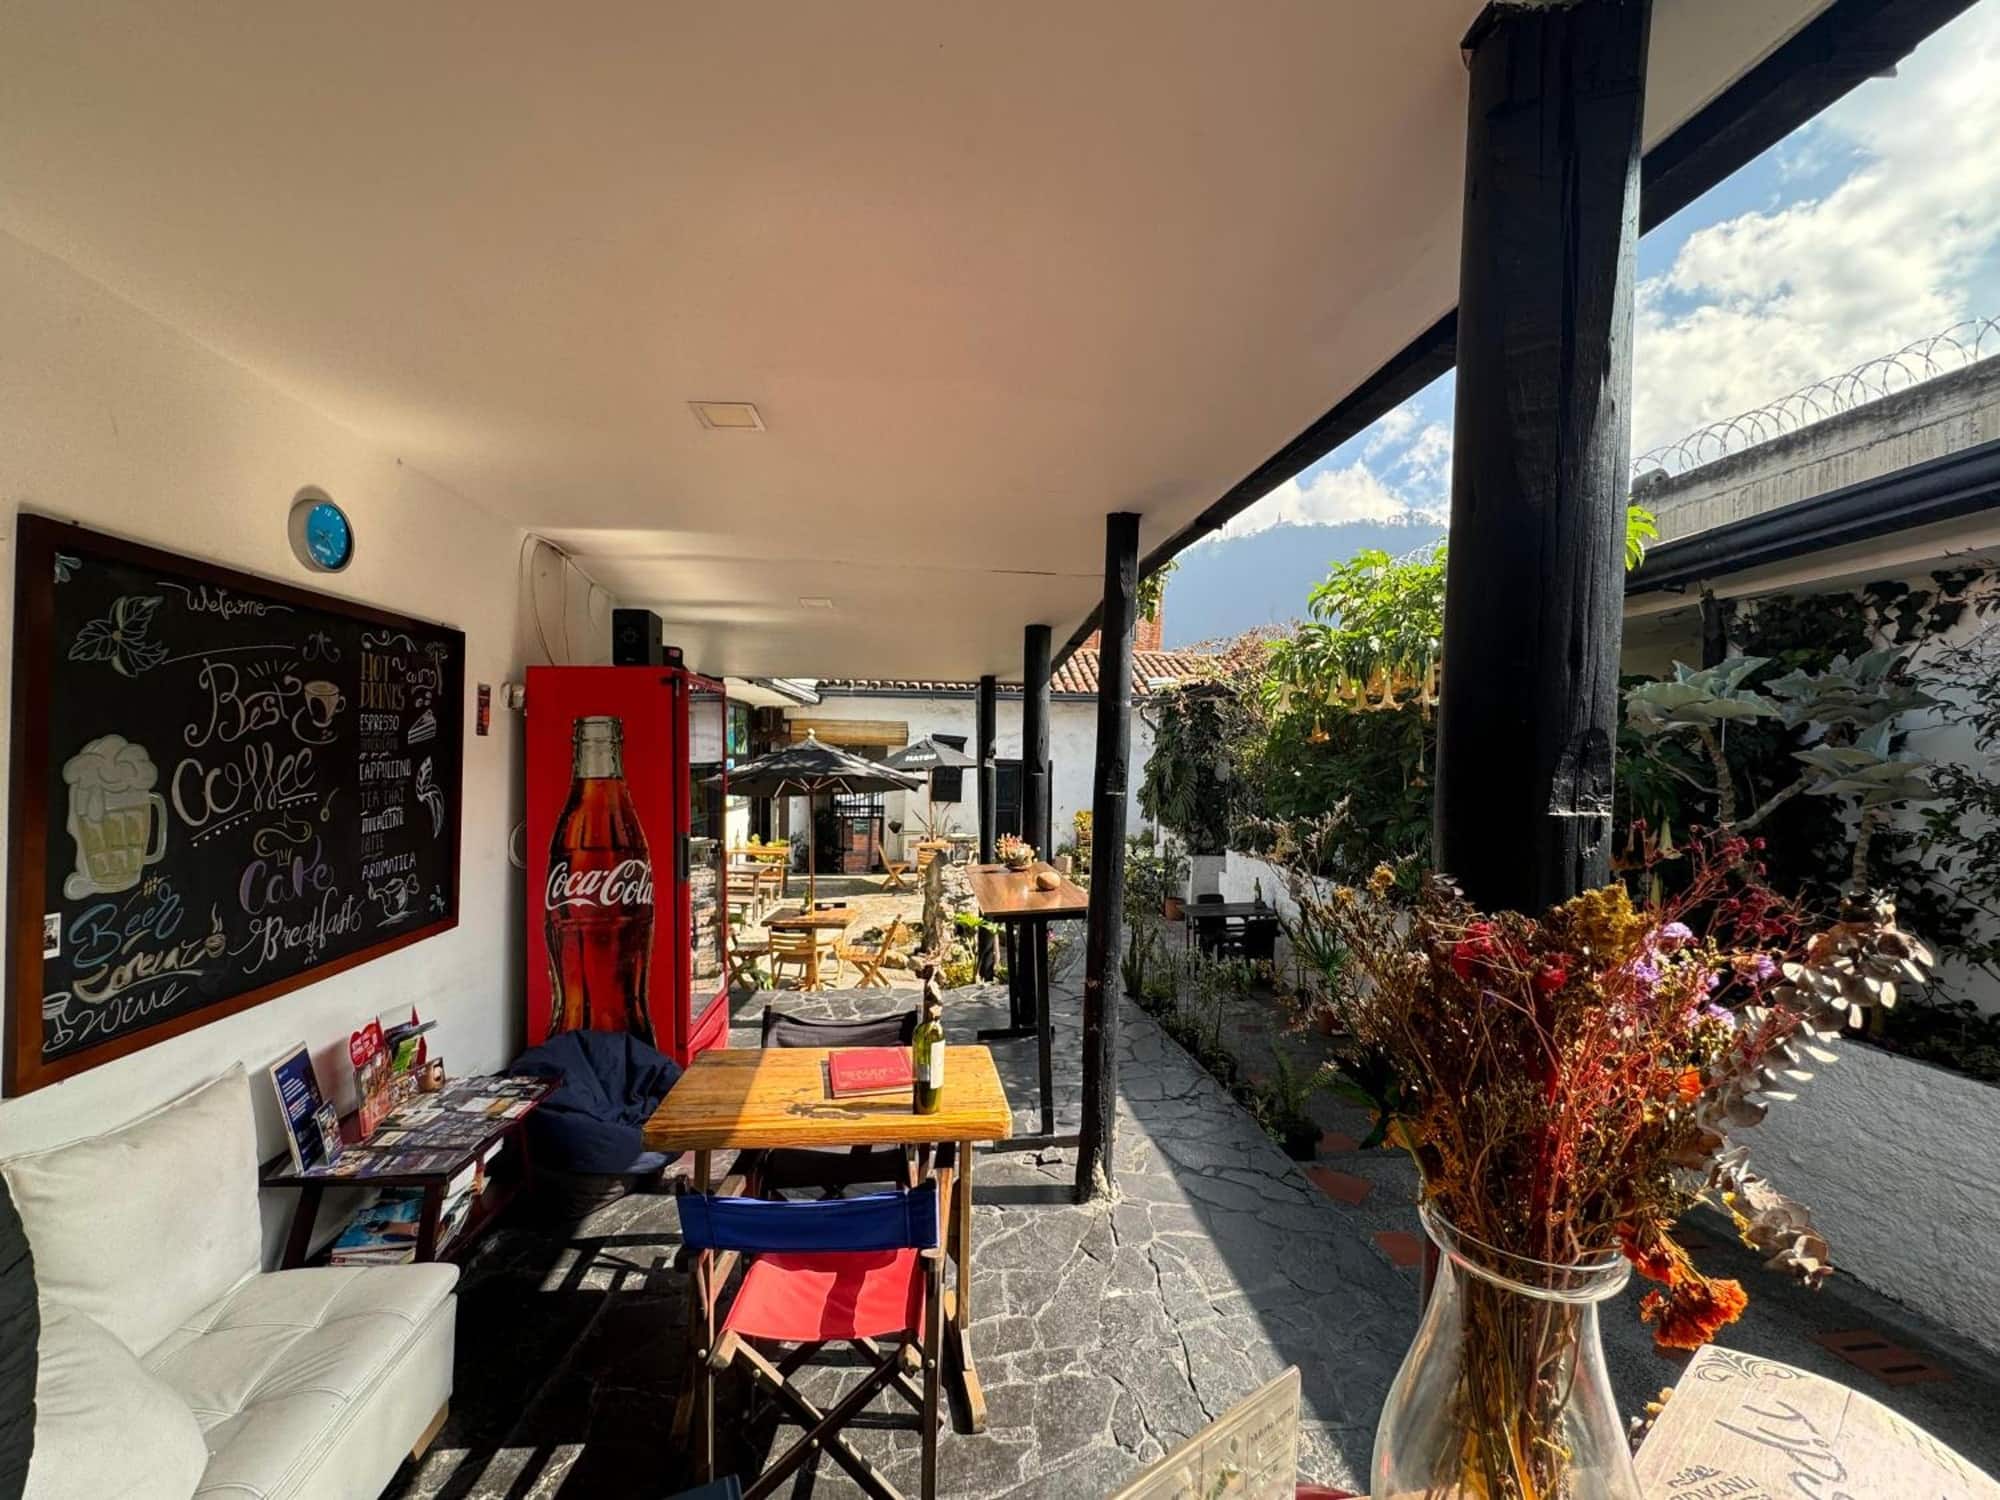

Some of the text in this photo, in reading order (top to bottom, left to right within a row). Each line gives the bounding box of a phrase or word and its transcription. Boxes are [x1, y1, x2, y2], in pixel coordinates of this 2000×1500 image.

[180, 584, 274, 620] Welcome
[361, 651, 390, 681] HOT
[184, 659, 301, 747] Best
[361, 682, 405, 710] DRINKS
[360, 713, 400, 731] ESPRESSO
[241, 840, 334, 914] Cake
[362, 852, 416, 880] AROMATICA
